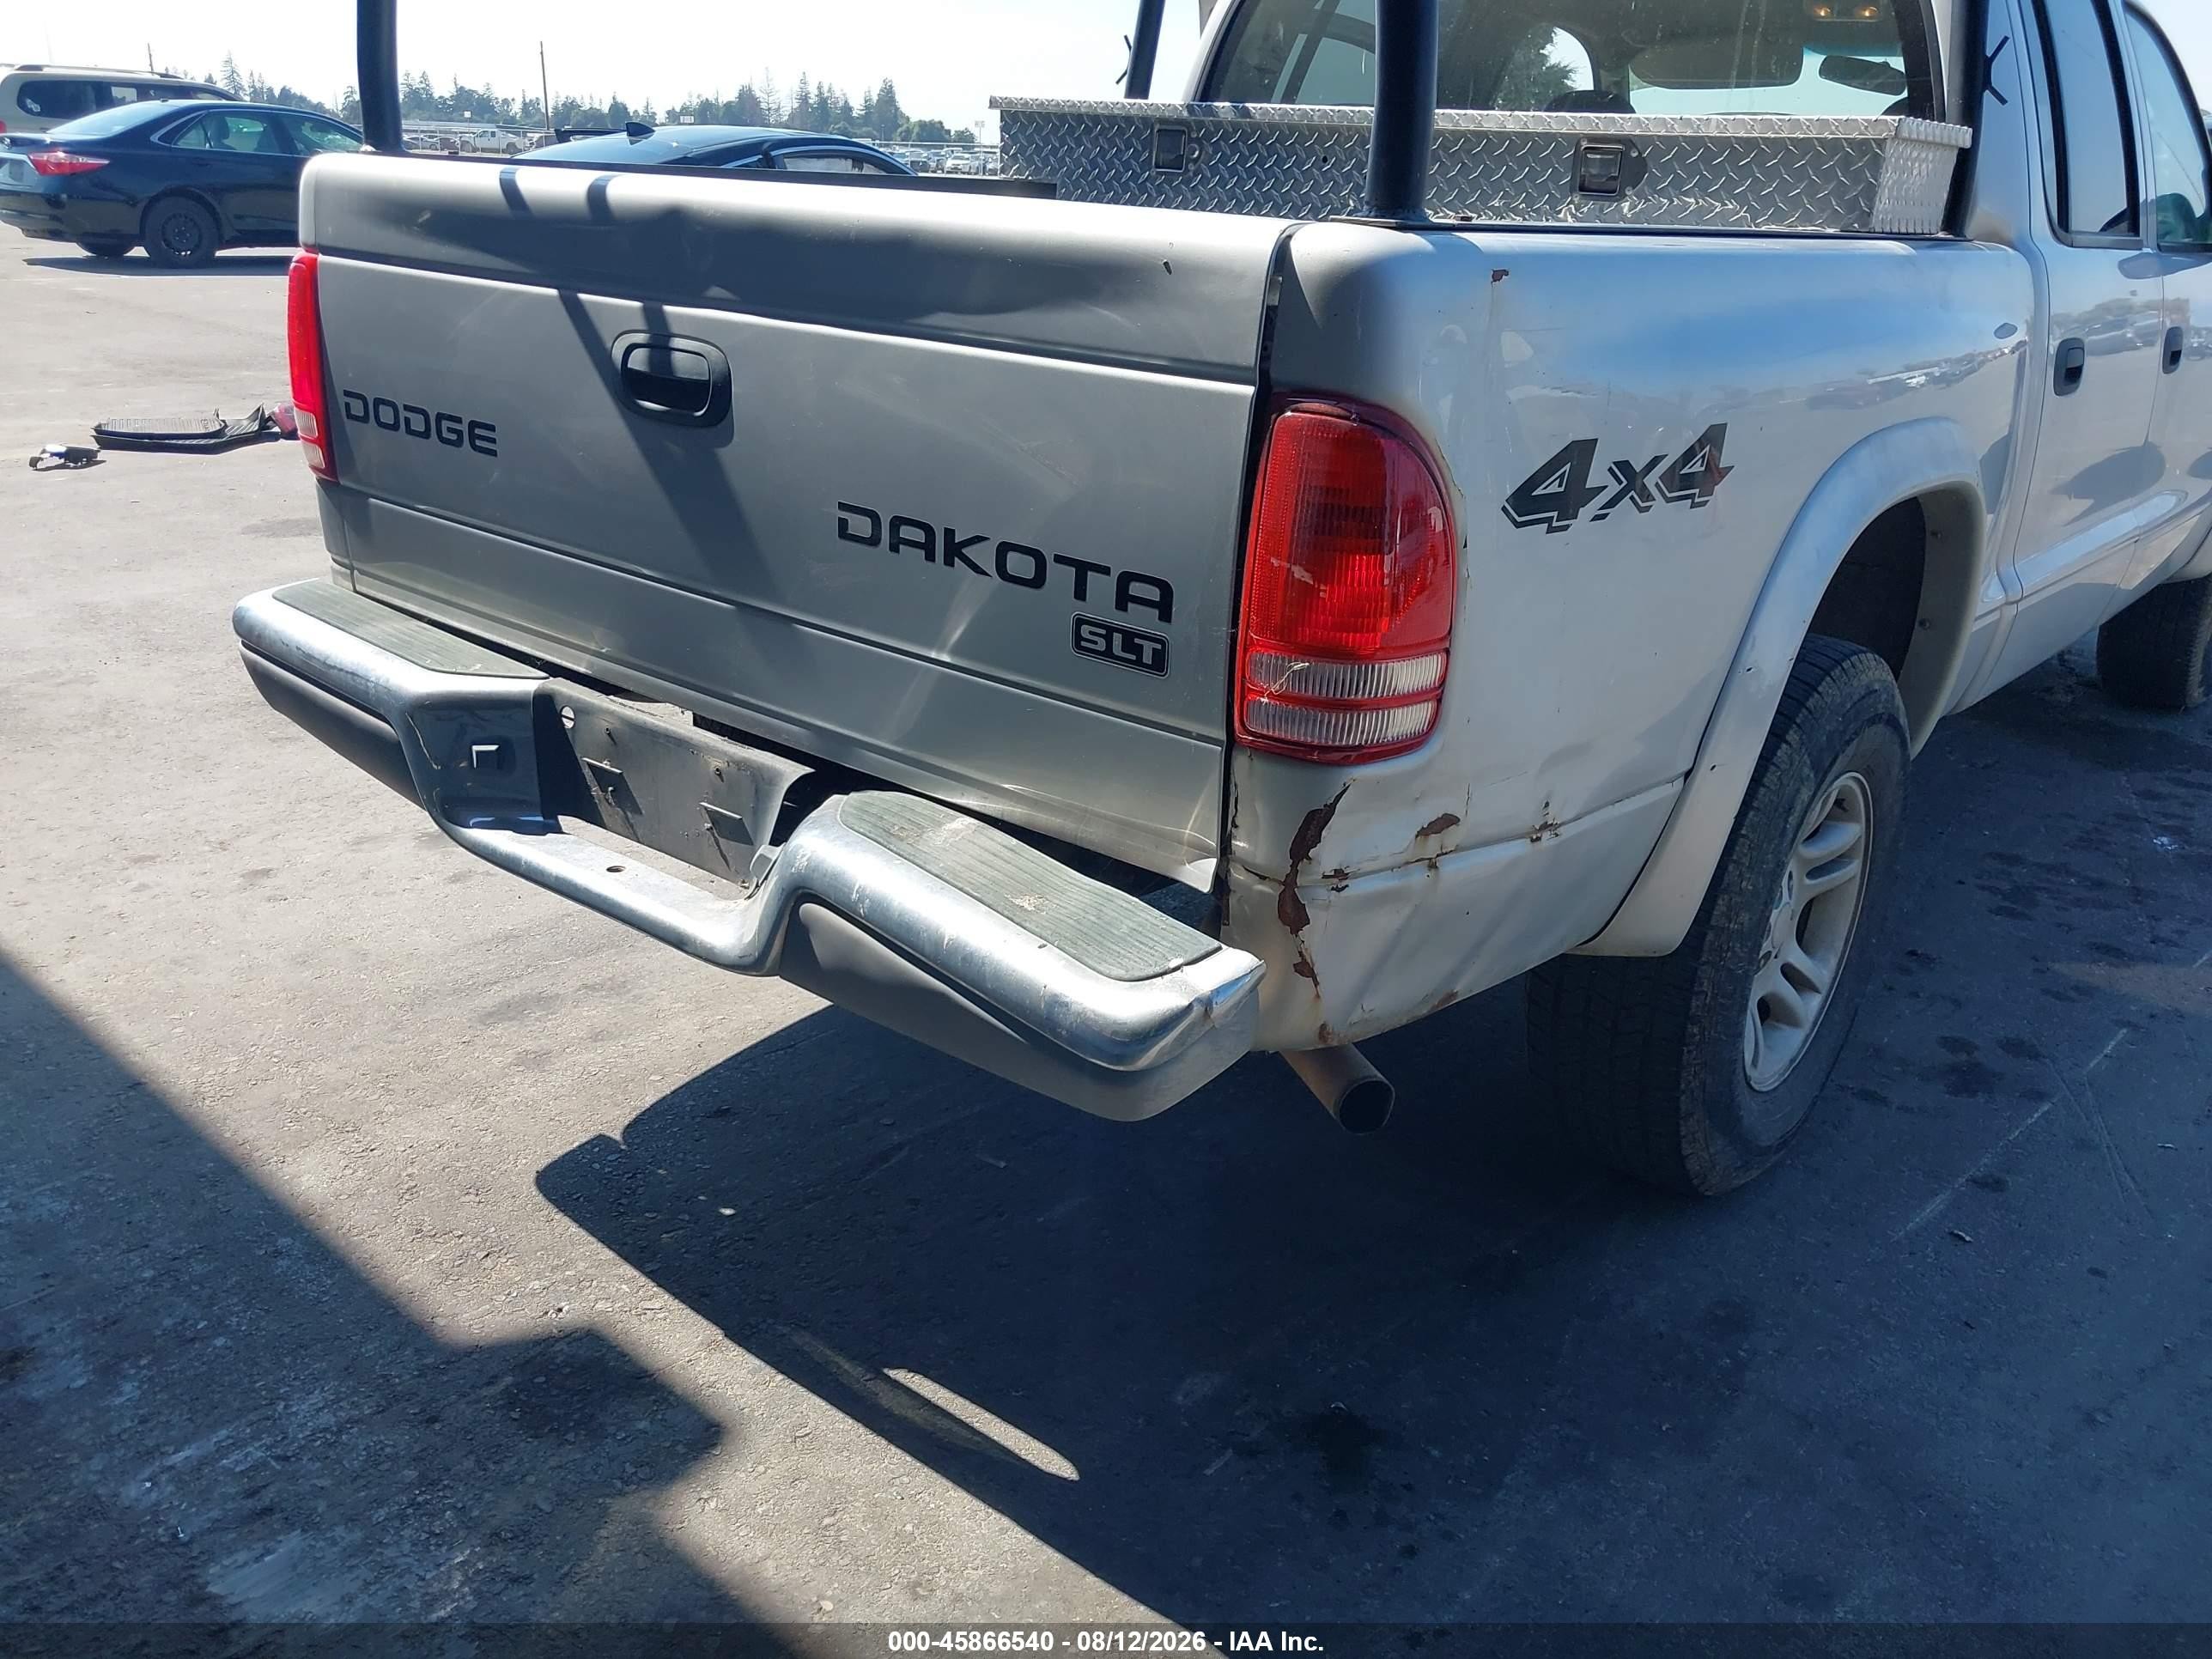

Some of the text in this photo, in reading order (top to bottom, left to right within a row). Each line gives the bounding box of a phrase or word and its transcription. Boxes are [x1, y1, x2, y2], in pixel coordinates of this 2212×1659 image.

[343, 389, 497, 458] DODGE
[1501, 422, 1735, 534] 4x4
[837, 501, 1175, 624] DAKOTA
[1079, 623, 1162, 665] SLT
